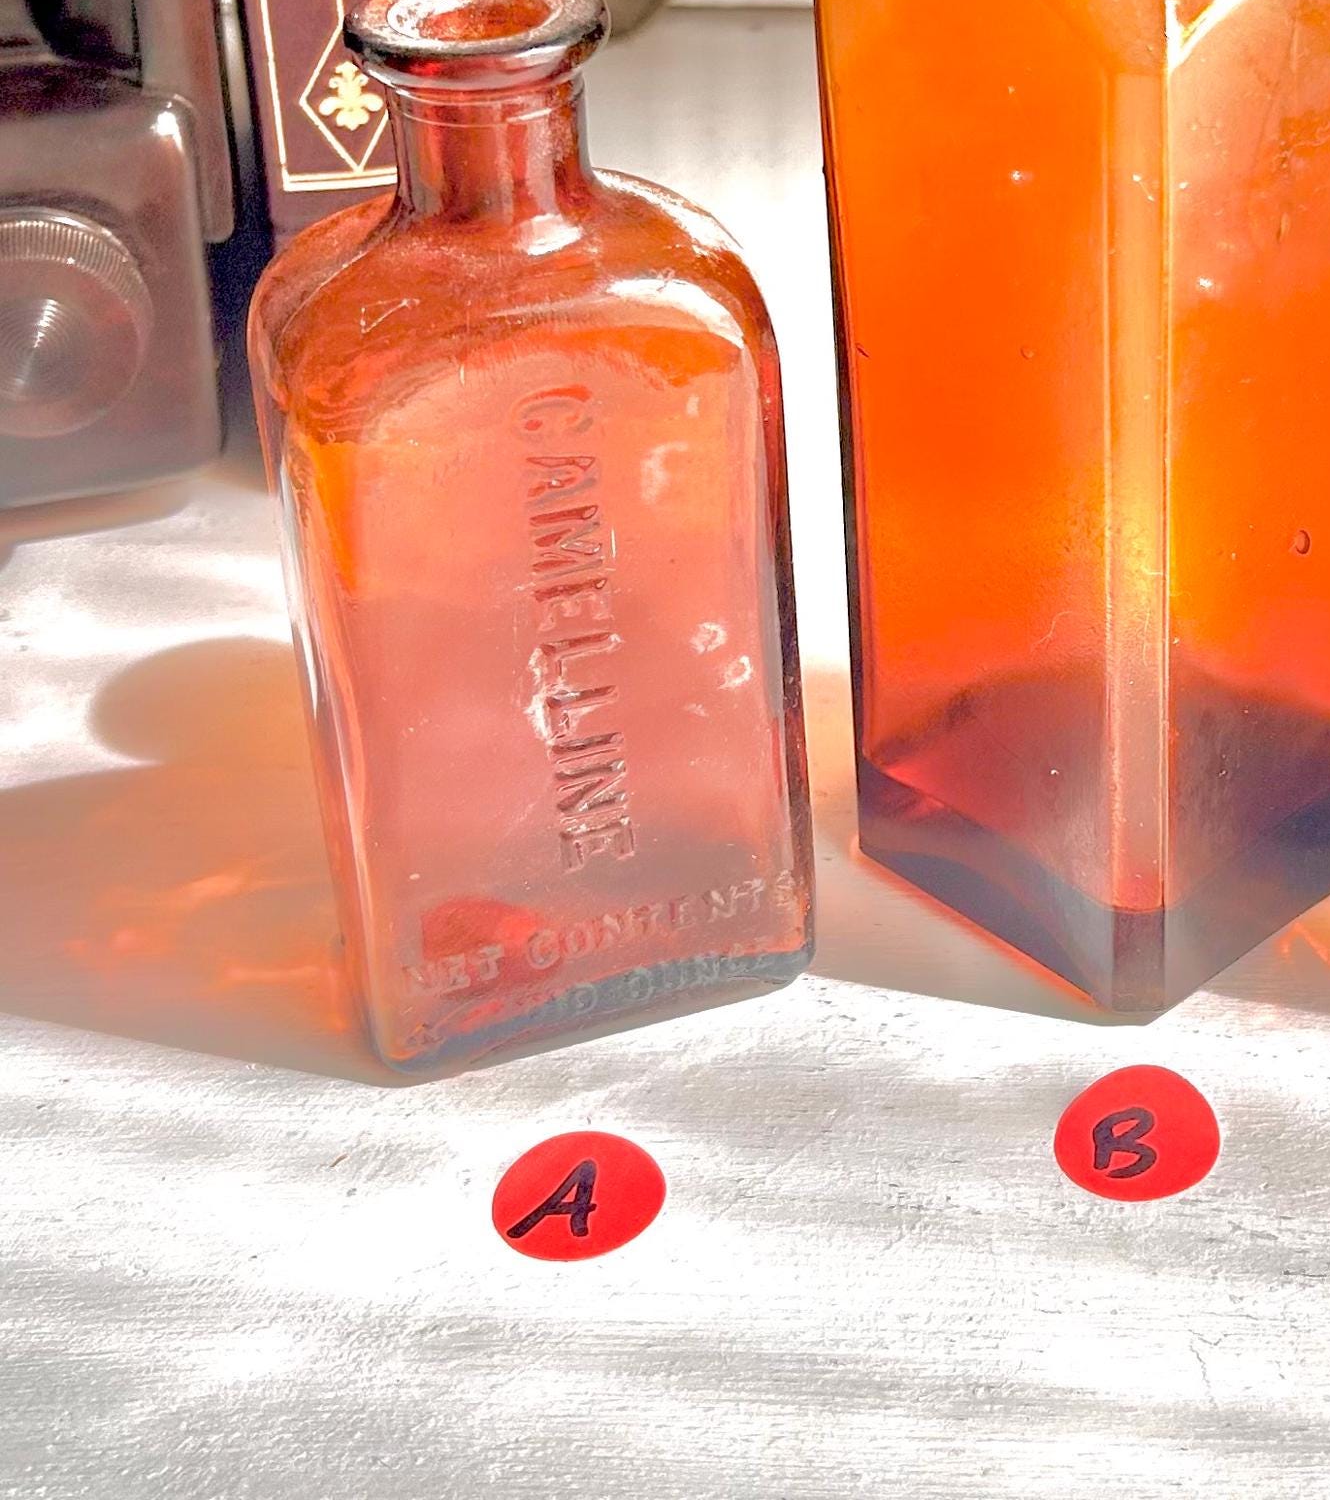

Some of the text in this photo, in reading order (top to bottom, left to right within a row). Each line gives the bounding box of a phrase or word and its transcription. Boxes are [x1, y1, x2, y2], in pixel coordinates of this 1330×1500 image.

[511, 385, 636, 874] CAMELLINE
[526, 870, 798, 972] CONTENTS
[1092, 1106, 1156, 1178] B
[506, 1159, 597, 1238] A
